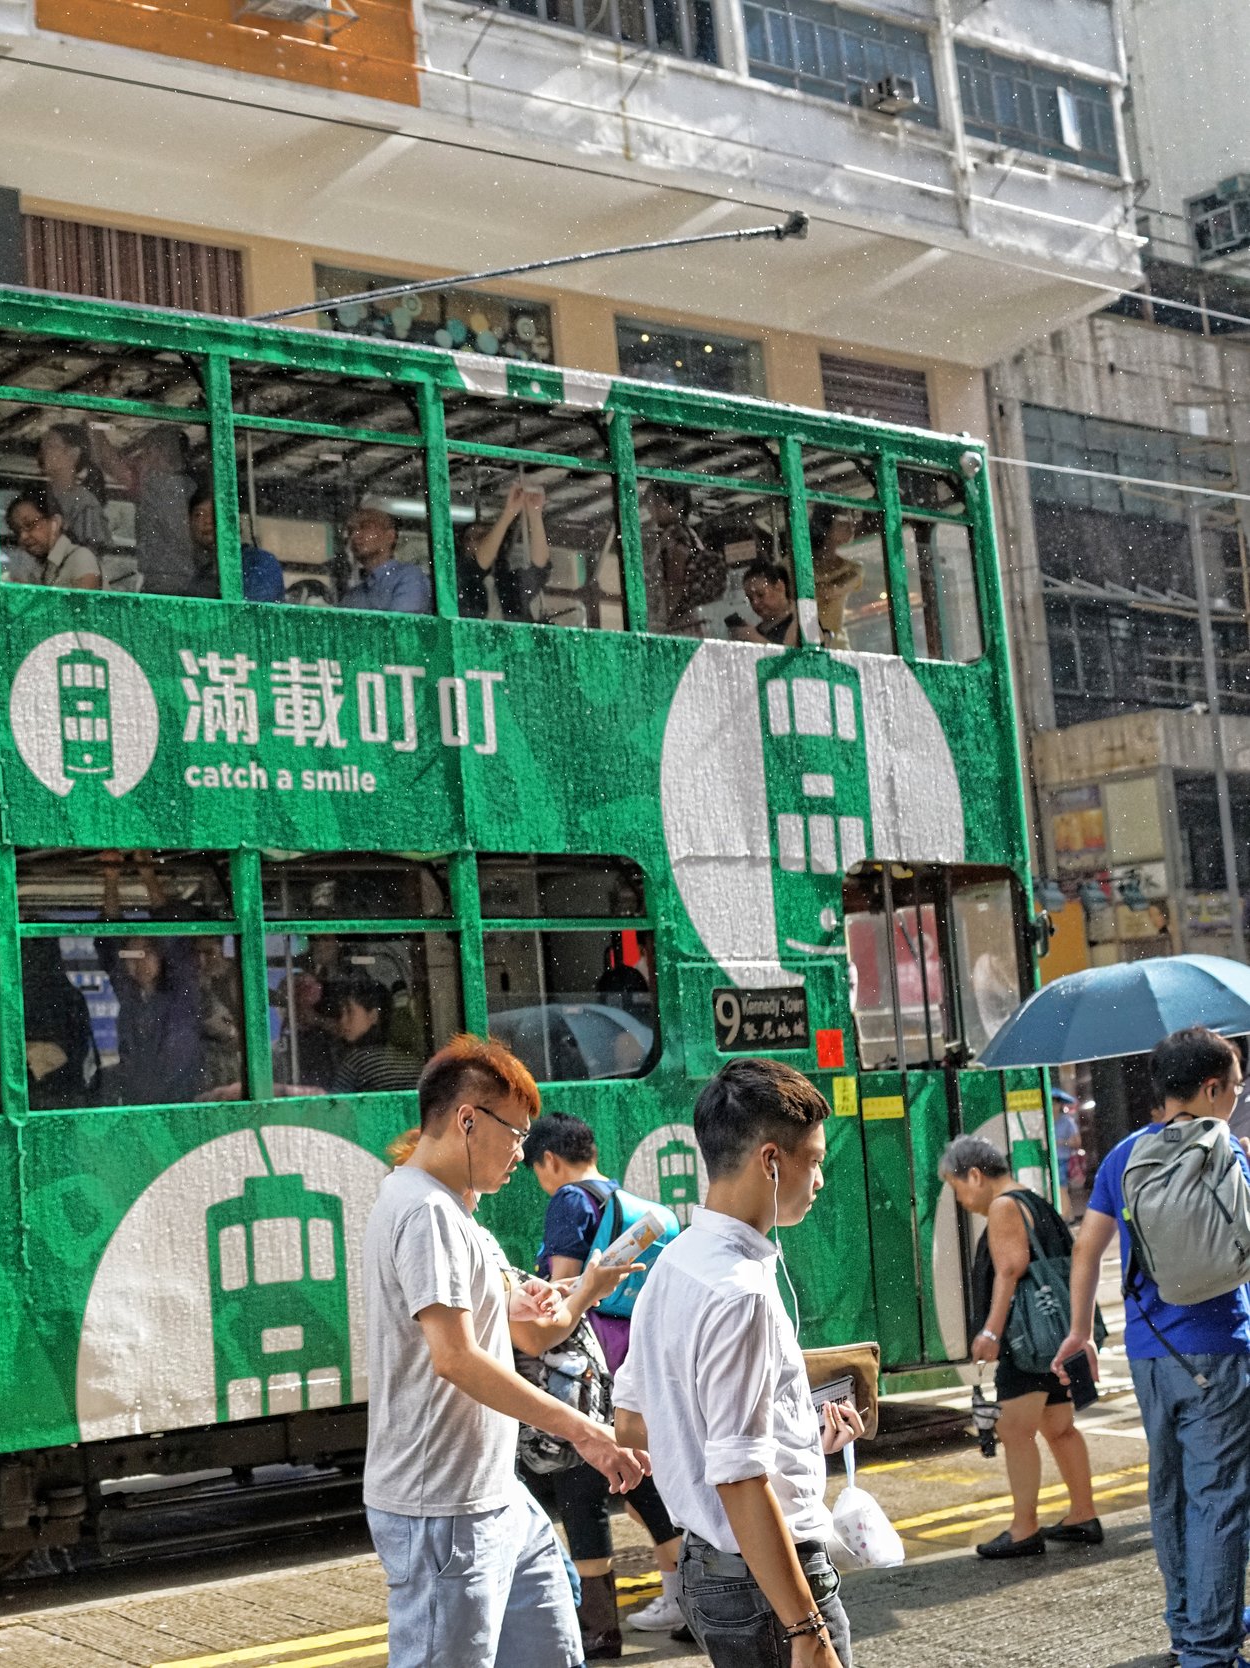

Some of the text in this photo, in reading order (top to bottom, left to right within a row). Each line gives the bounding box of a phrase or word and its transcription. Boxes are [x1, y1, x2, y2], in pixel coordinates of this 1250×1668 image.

[178, 649, 505, 755] 滿載叮叮
[184, 761, 377, 793] catch a smile
[715, 992, 741, 1046] 9
[741, 995, 780, 1018] Kennedy
